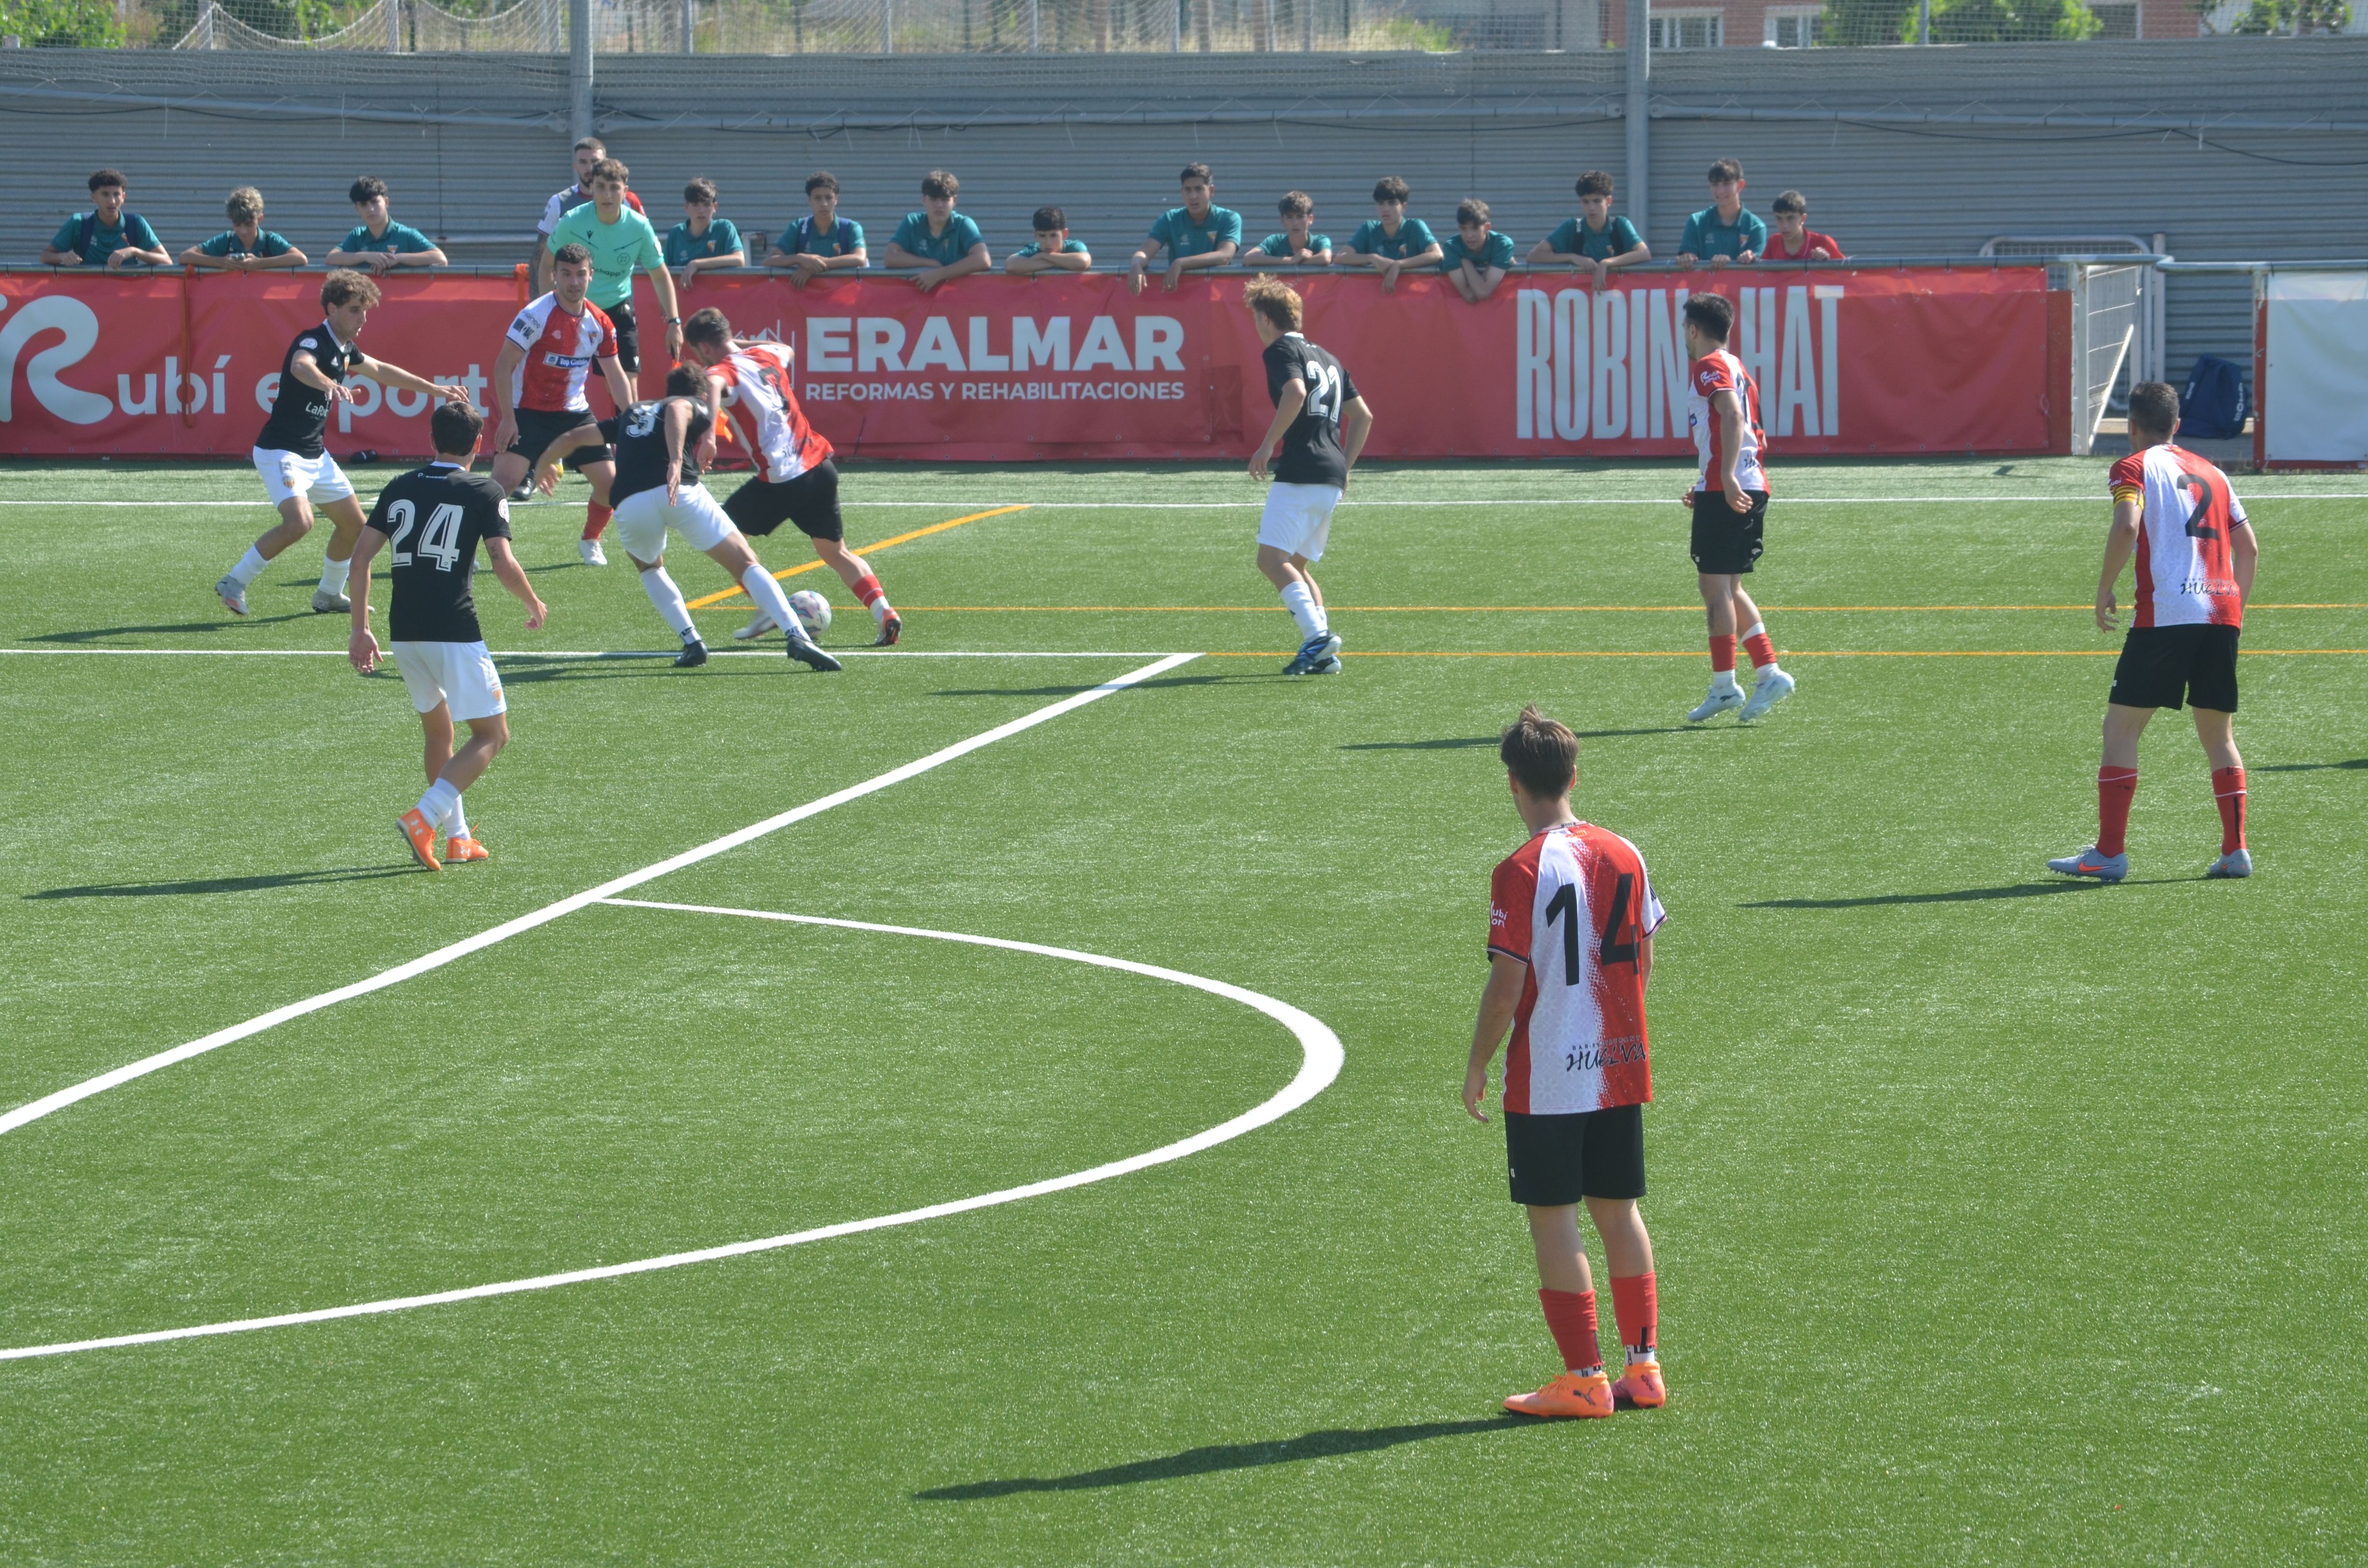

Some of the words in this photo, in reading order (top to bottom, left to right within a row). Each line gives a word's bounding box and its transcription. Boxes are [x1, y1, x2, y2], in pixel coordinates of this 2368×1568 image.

[806, 316, 1185, 372] ERALMAR
[1517, 288, 1689, 441] ROBIN
[1740, 285, 1844, 437] HAT
[806, 382, 934, 400] REFORMAS
[939, 383, 956, 400] Y
[962, 382, 1184, 400] REHABILITACIONES
[1306, 360, 1342, 423] 21
[387, 499, 465, 572] 24
[2177, 474, 2218, 539] 2
[1545, 872, 1639, 986] 14
[1566, 1041, 1647, 1072] HUELVA
